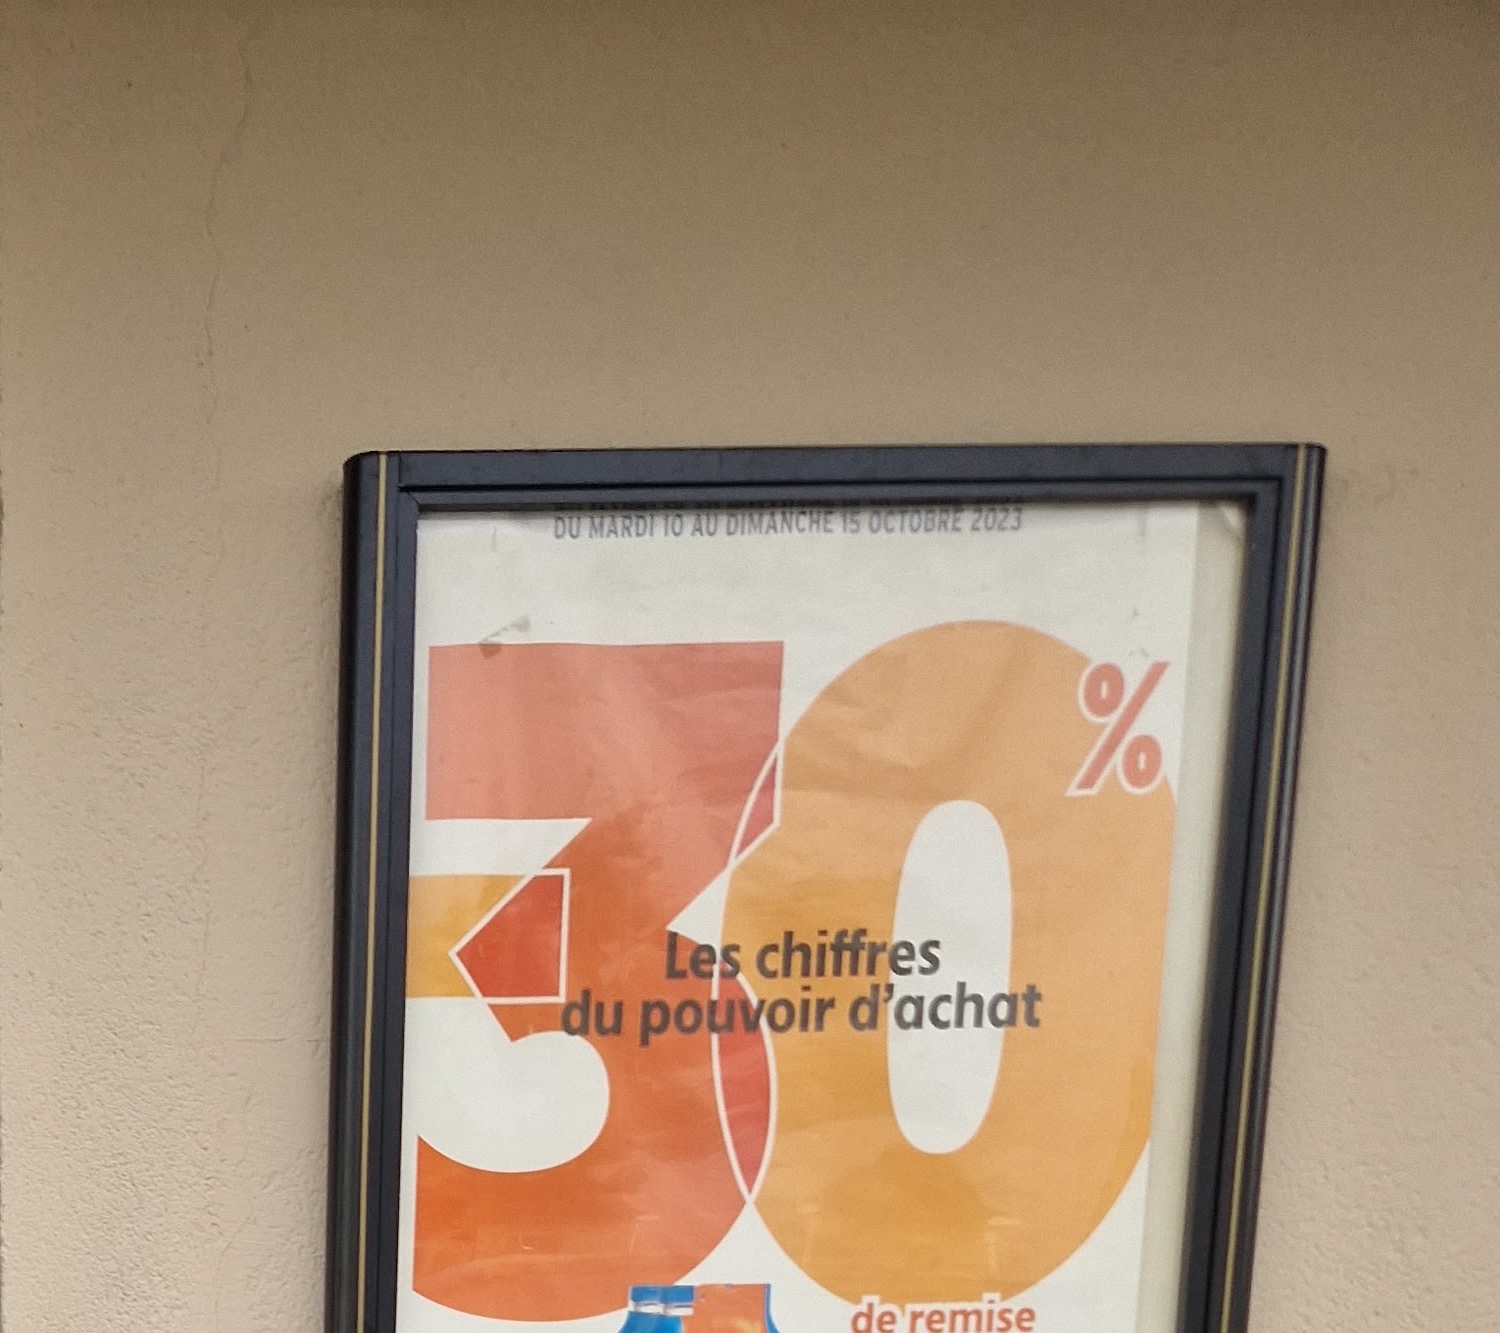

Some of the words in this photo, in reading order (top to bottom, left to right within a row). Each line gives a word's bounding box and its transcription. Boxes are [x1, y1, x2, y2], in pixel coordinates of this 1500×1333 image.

[589, 513, 655, 539] MARDI
[691, 511, 719, 537] AU
[726, 508, 834, 536] DIMANCHE
[841, 508, 861, 534] 15
[868, 506, 965, 534] OCTOBRE
[971, 504, 1023, 532] 2023
[666, 931, 740, 980] Les
[756, 927, 941, 980] chiffres
[559, 988, 623, 1036] du
[639, 984, 835, 1048] pouvoir
[848, 981, 1043, 1032] d'achat
[909, 1299, 1036, 1333] remise
